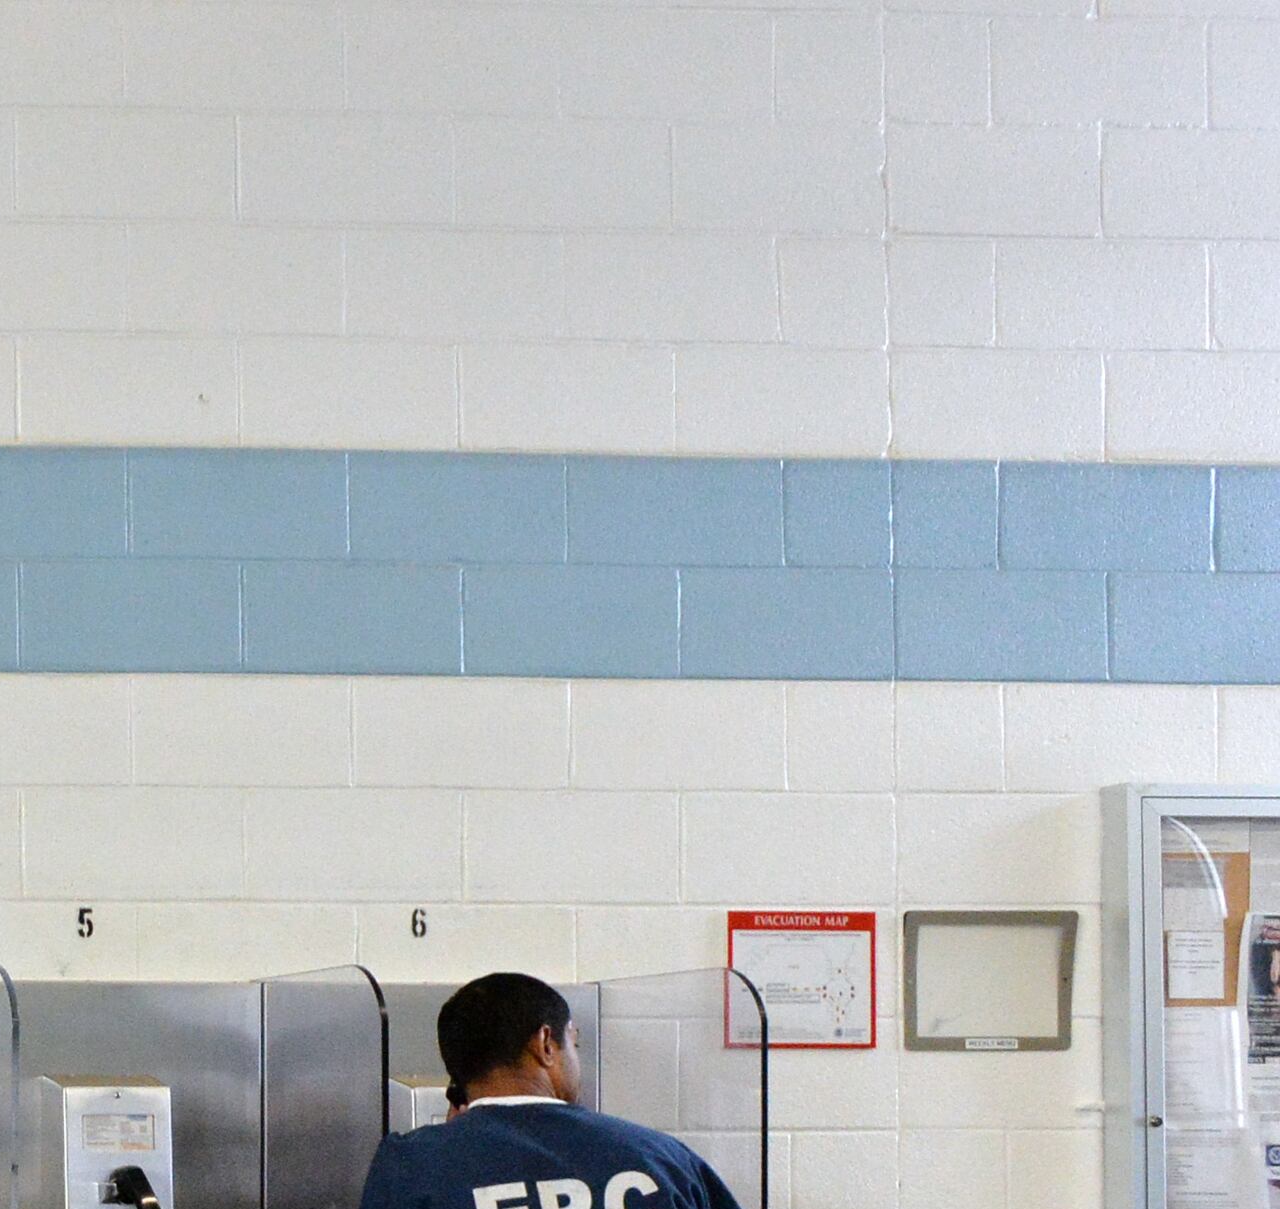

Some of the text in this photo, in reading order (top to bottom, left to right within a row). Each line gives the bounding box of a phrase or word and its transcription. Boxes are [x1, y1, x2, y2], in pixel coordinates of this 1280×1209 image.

[77, 907, 94, 938] 5
[411, 908, 427, 938] 6
[754, 915, 849, 926] EVACUATION MAP
